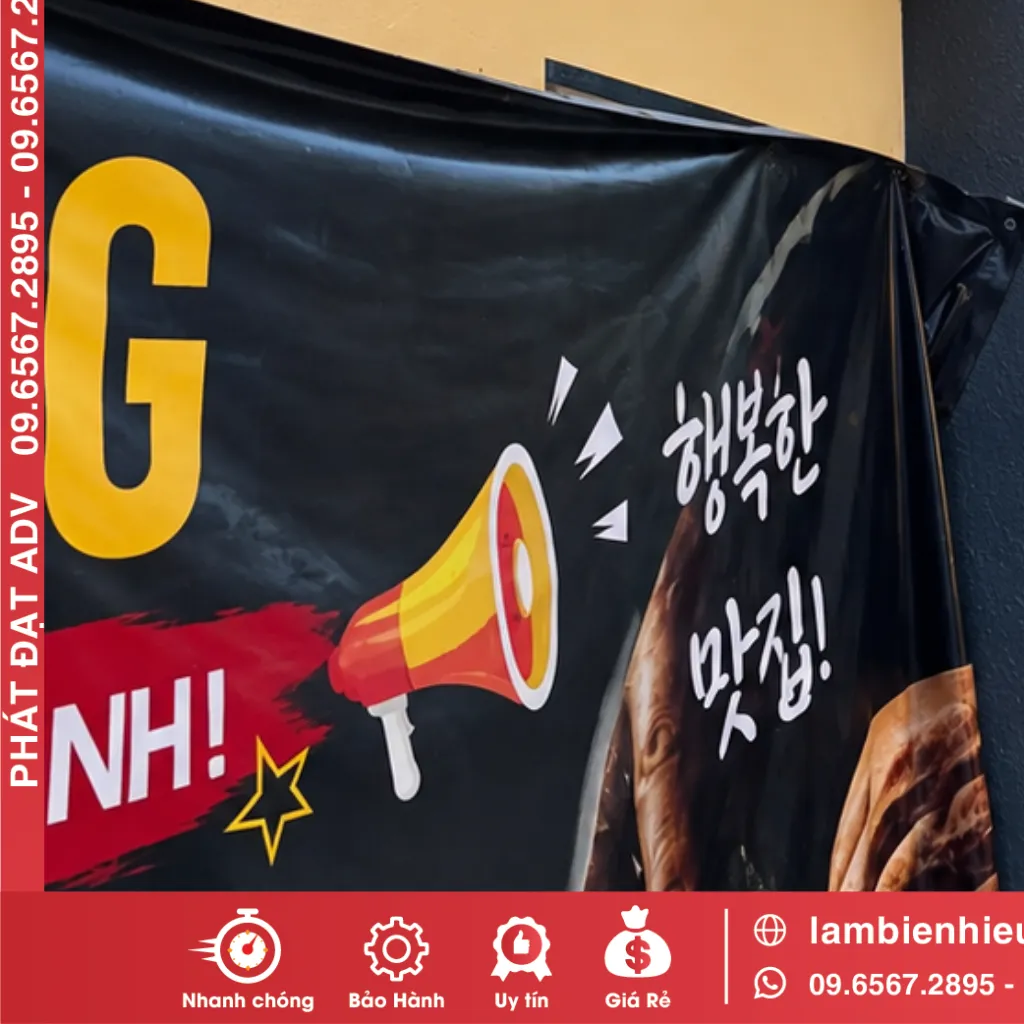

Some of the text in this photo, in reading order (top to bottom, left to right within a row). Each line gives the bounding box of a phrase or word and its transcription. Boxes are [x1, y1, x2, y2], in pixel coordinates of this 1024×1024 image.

[662, 356, 829, 536] 행복한
[47, 669, 226, 825] NH!
[689, 565, 832, 761] 맛집!
